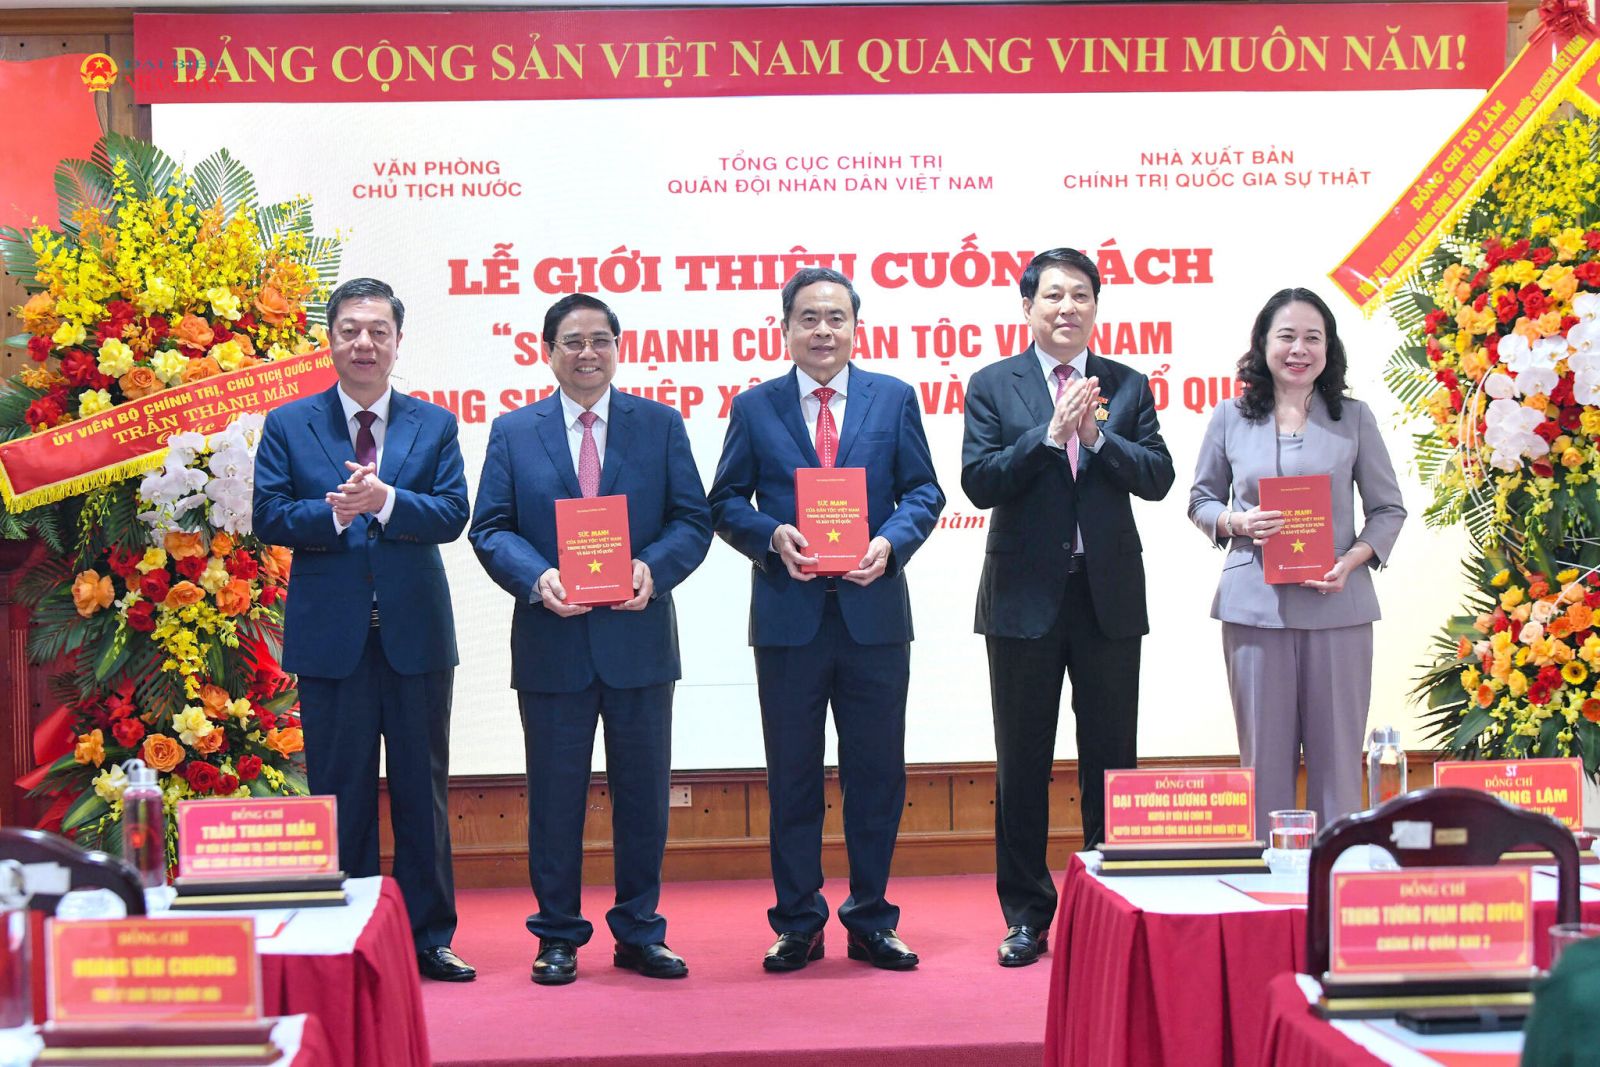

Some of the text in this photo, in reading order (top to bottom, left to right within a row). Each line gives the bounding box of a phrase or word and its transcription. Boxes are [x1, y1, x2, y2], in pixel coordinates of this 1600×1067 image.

[172, 25, 1467, 93] ĐẢNG CỘNG SẢN VIỆT NAM QUANG VINH MUÔN NĂM!
[373, 157, 500, 176] VĂN PHÒNG
[718, 149, 943, 173] TỔNG CỤC CHÍNH TRỊ
[1140, 145, 1294, 166] NHÀ XUẤT BẢN
[1410, 100, 1506, 211] ĐỒNG CHÍ TÔ LÂM
[352, 178, 522, 200] CHỦ TỊCH NƯỚC
[667, 172, 993, 195] QUÂN ĐỘI NHÂN DÂN VIỆT NAM
[1063, 167, 1371, 191] CHÍNH TRỊ QUỐC GIA SỰ THẬT
[448, 242, 520, 296] LỄ
[533, 244, 662, 294] GIỚI
[871, 232, 1035, 289] CUỐN
[1081, 237, 1214, 286] ÁCH
[617, 328, 719, 371] MẠNH
[733, 315, 791, 361] CỦ
[851, 318, 899, 360] ÂN
[911, 317, 982, 366] TỘC
[994, 323, 1034, 357] VI
[1091, 321, 1173, 355] NAM
[52, 354, 334, 447] ỦY VIÊN BỘ CHÍNH TRỊ, CHỦ TỊCH QUỐC HỘI
[920, 373, 966, 415] VÀ
[1149, 363, 1170, 411] Ổ
[1183, 376, 1245, 414] QU
[113, 412, 180, 445] TRẦN
[183, 391, 260, 422] THANH
[264, 378, 300, 403] MẪN
[934, 512, 985, 530] năm
[1485, 775, 1533, 788] ĐỒNG CHÍ
[1505, 765, 1518, 777] ST
[1155, 776, 1205, 790] ĐỒNG CHÍ
[1113, 794, 1132, 810] ĐẠI
[1536, 787, 1568, 804] LÂM
